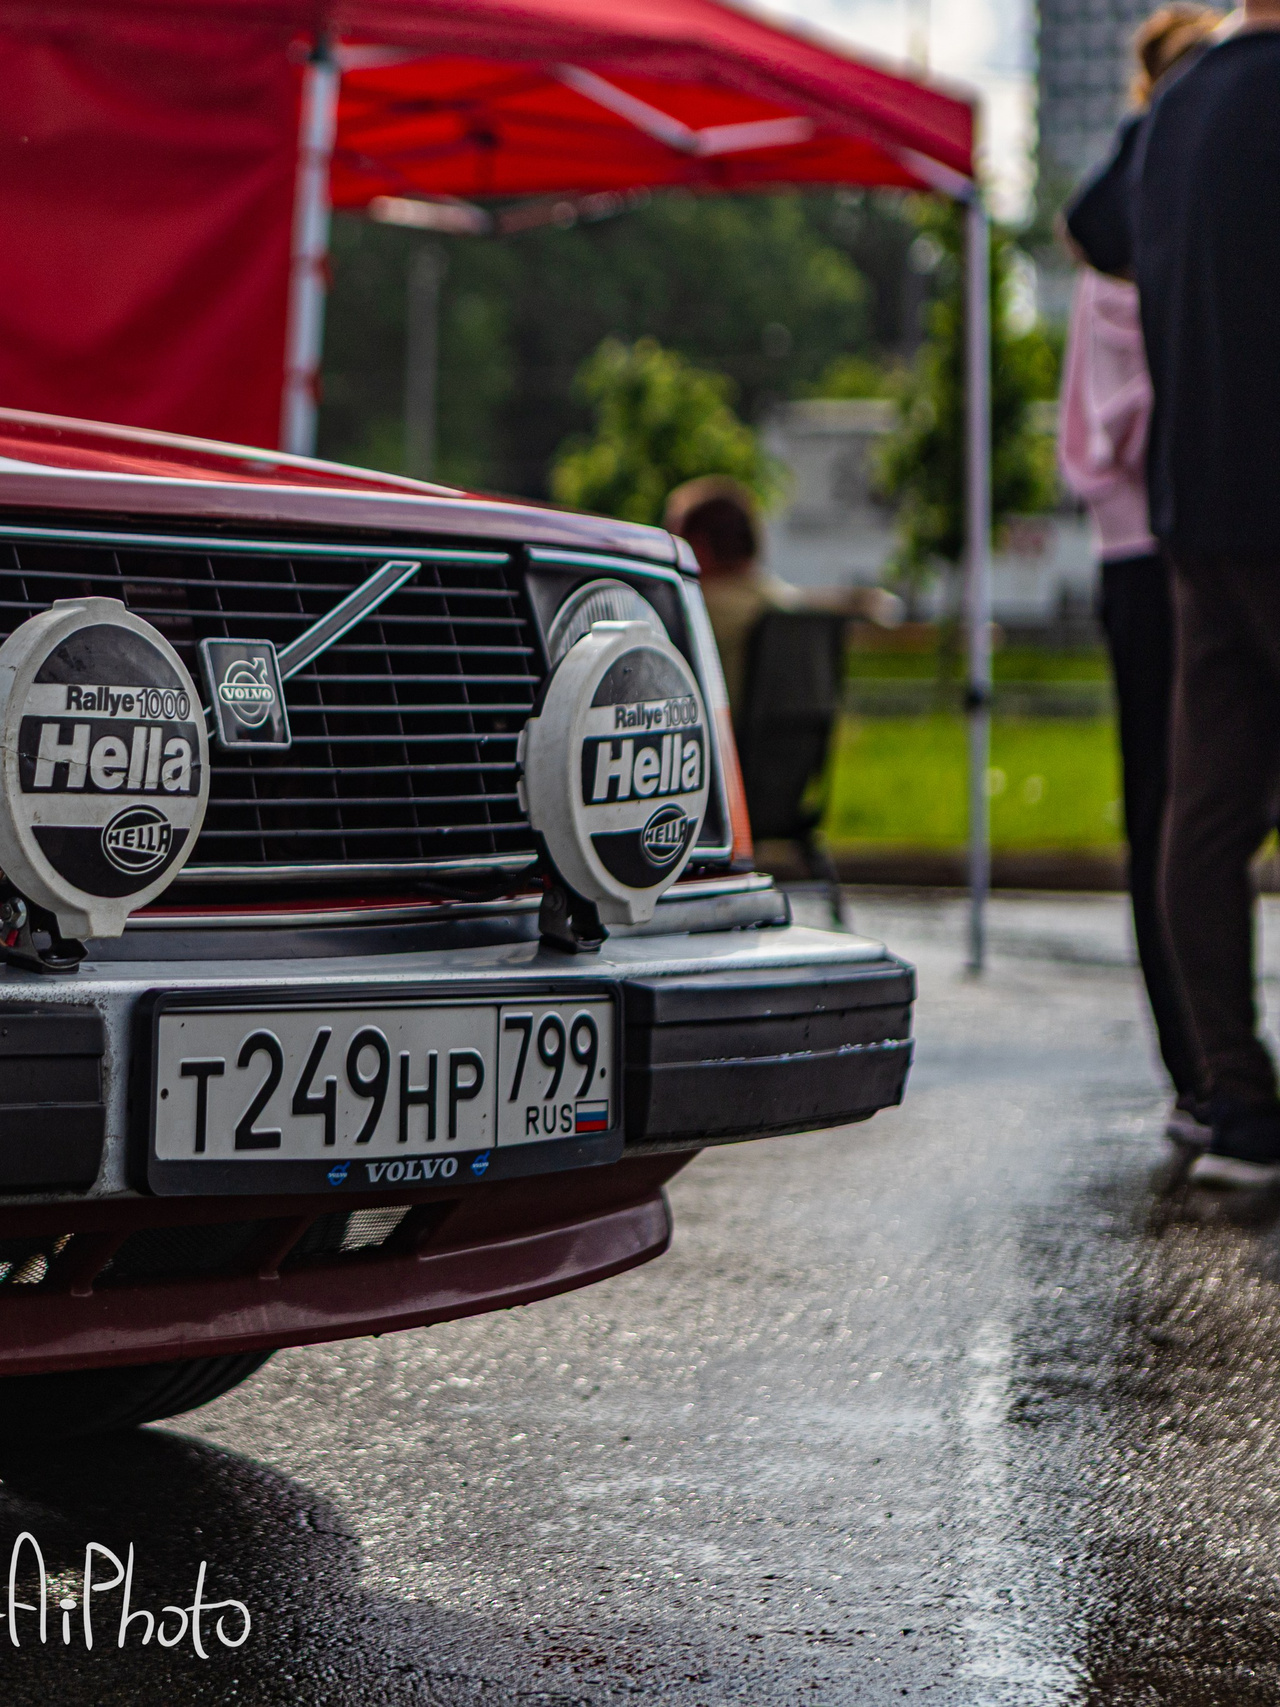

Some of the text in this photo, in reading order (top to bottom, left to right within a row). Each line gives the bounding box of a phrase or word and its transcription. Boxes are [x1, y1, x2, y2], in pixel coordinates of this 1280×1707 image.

[66, 685, 191, 720] Rallye 1000
[222, 686, 273, 700] VOLVO
[615, 697, 699, 729] Rallye 1000
[33, 722, 192, 792] Hella
[593, 734, 701, 800] Hella
[107, 824, 171, 854] HELLA
[645, 816, 688, 844] HELLA
[503, 1010, 600, 1103] 799
[526, 1102, 574, 1136] RUS
[365, 1157, 459, 1183] VOLVO
